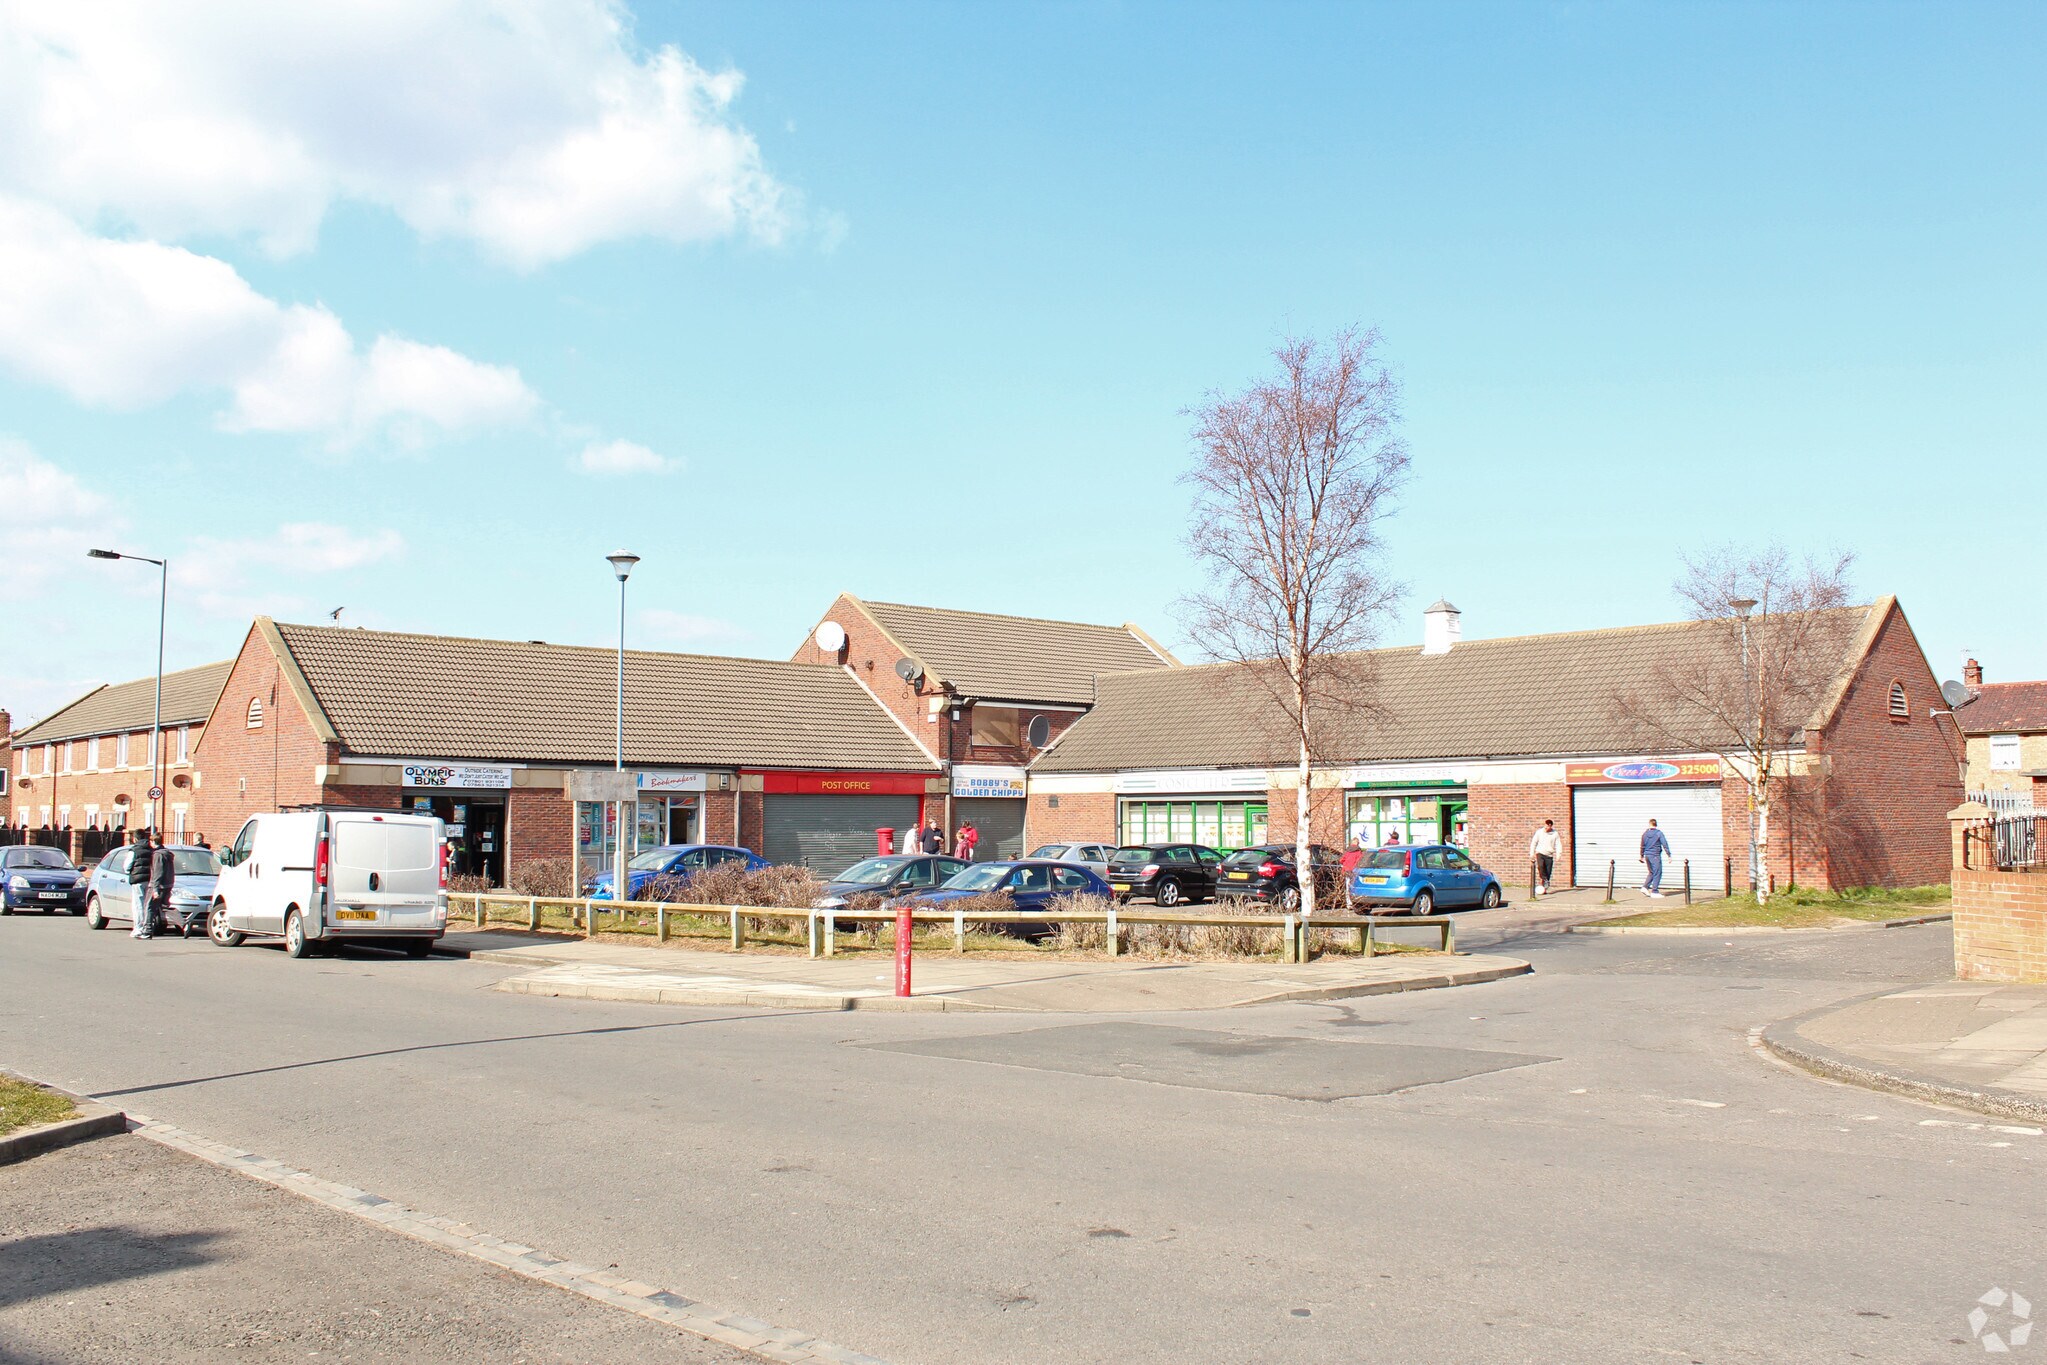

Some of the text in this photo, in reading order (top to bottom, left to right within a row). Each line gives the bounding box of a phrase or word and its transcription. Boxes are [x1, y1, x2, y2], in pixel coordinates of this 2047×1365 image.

[405, 767, 455, 776] OLYMPIC
[1681, 764, 1719, 774] 325000
[414, 777, 446, 786] BUNS
[651, 774, 697, 788] Bookmakers
[822, 781, 871, 790] POST OFFICE
